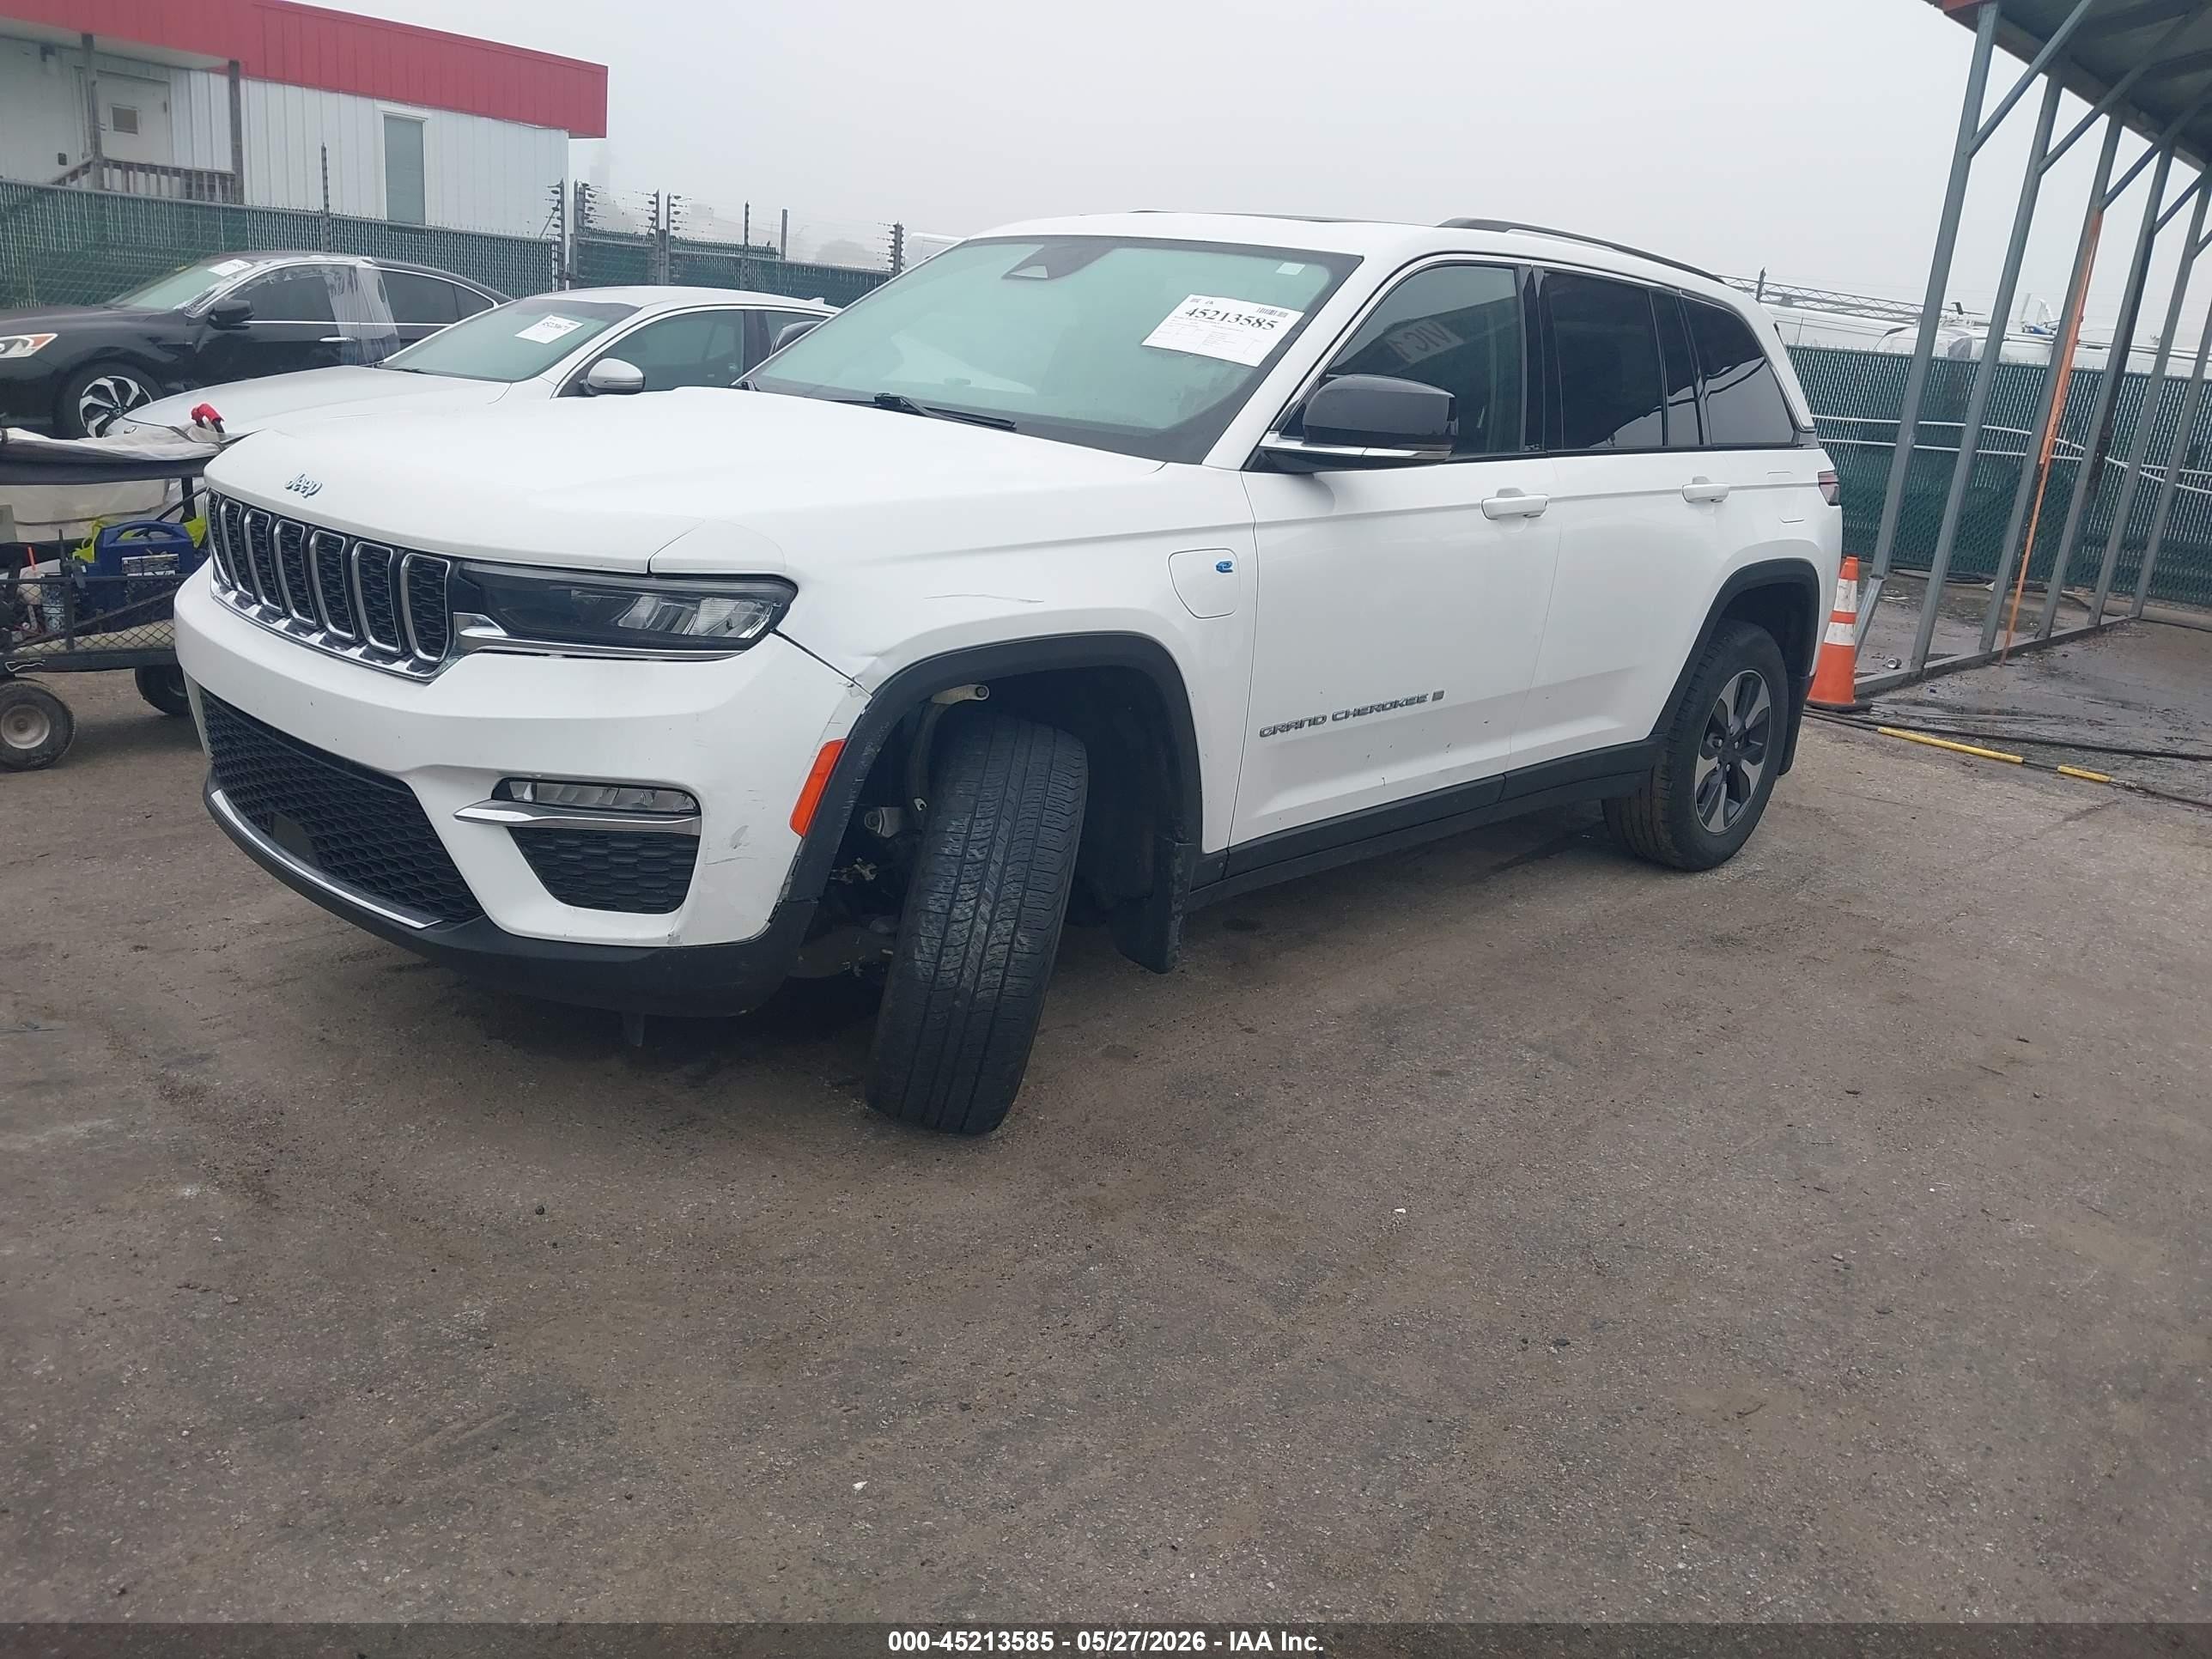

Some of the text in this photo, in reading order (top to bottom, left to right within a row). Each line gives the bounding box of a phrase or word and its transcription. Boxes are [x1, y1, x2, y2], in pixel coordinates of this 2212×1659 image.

[1185, 307, 1279, 330] 45213585
[284, 473, 322, 498] Jeep
[1259, 693, 1430, 738] GRAND CHEROKEE
